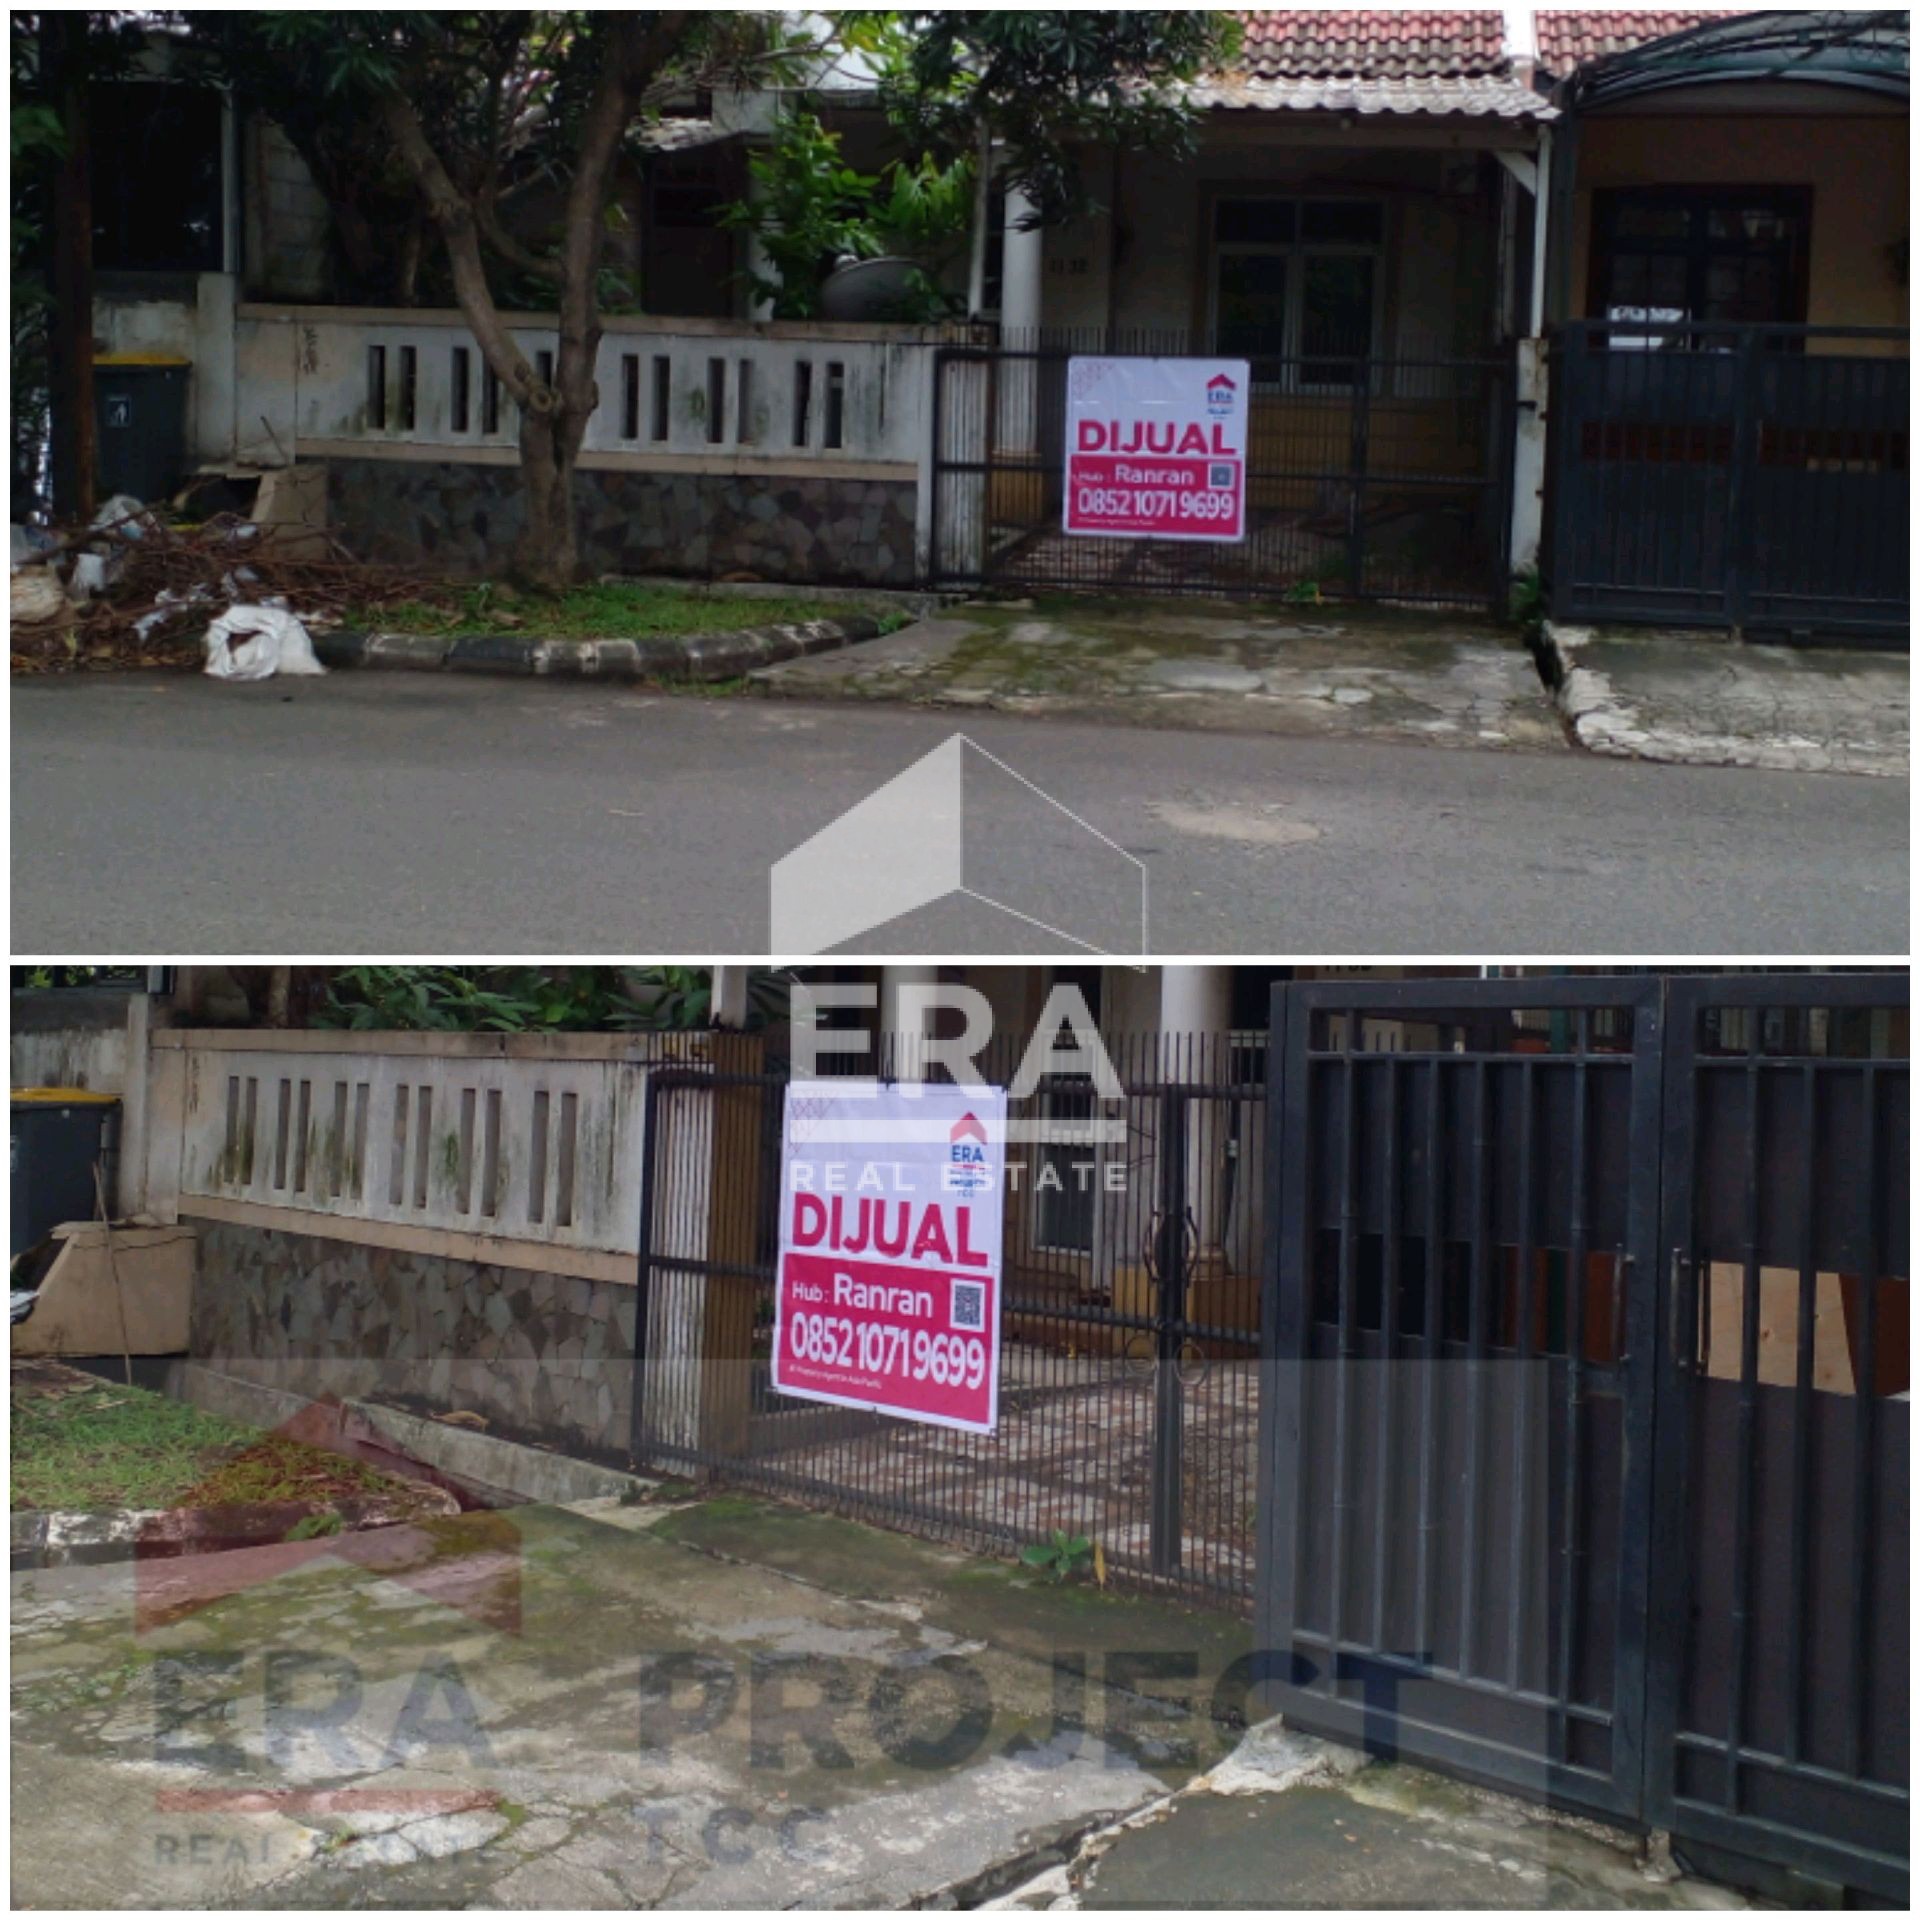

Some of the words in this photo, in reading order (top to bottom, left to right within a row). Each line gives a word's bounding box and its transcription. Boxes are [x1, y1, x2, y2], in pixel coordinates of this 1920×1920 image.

[1078, 420, 1237, 455] DIJUAL
[1115, 464, 1195, 485] Ranran
[952, 1145, 985, 1163] ERA
[793, 1191, 988, 1268] DIJUAL
[834, 1272, 934, 1318] Ranran
